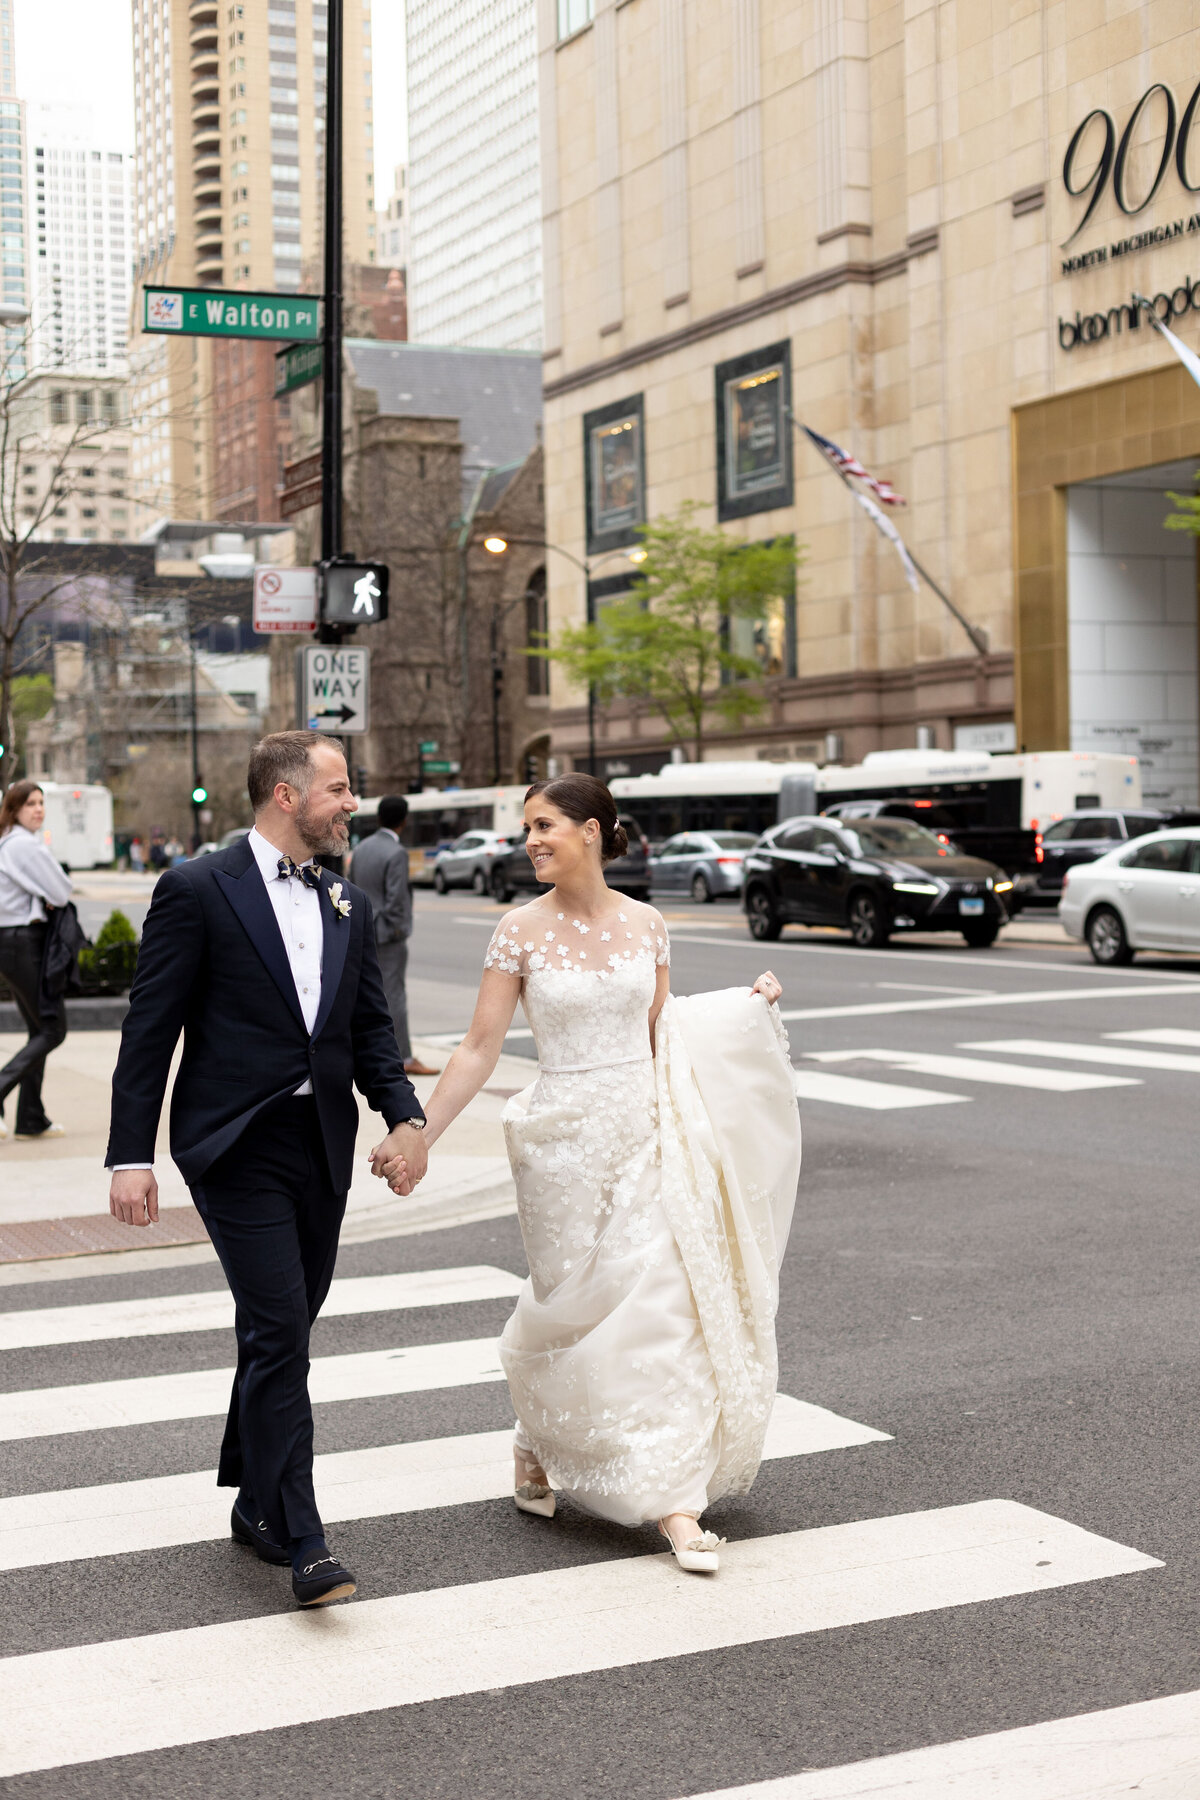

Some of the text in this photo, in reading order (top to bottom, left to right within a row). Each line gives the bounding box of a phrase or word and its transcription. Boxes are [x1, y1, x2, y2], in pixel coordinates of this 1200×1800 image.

[1062, 245, 1107, 275] NORTH
[1111, 218, 1184, 258] MICHIGAN
[189, 304, 198, 318] E
[205, 299, 290, 329] Walton
[313, 654, 360, 674] ONE
[312, 678, 360, 697] WAY
